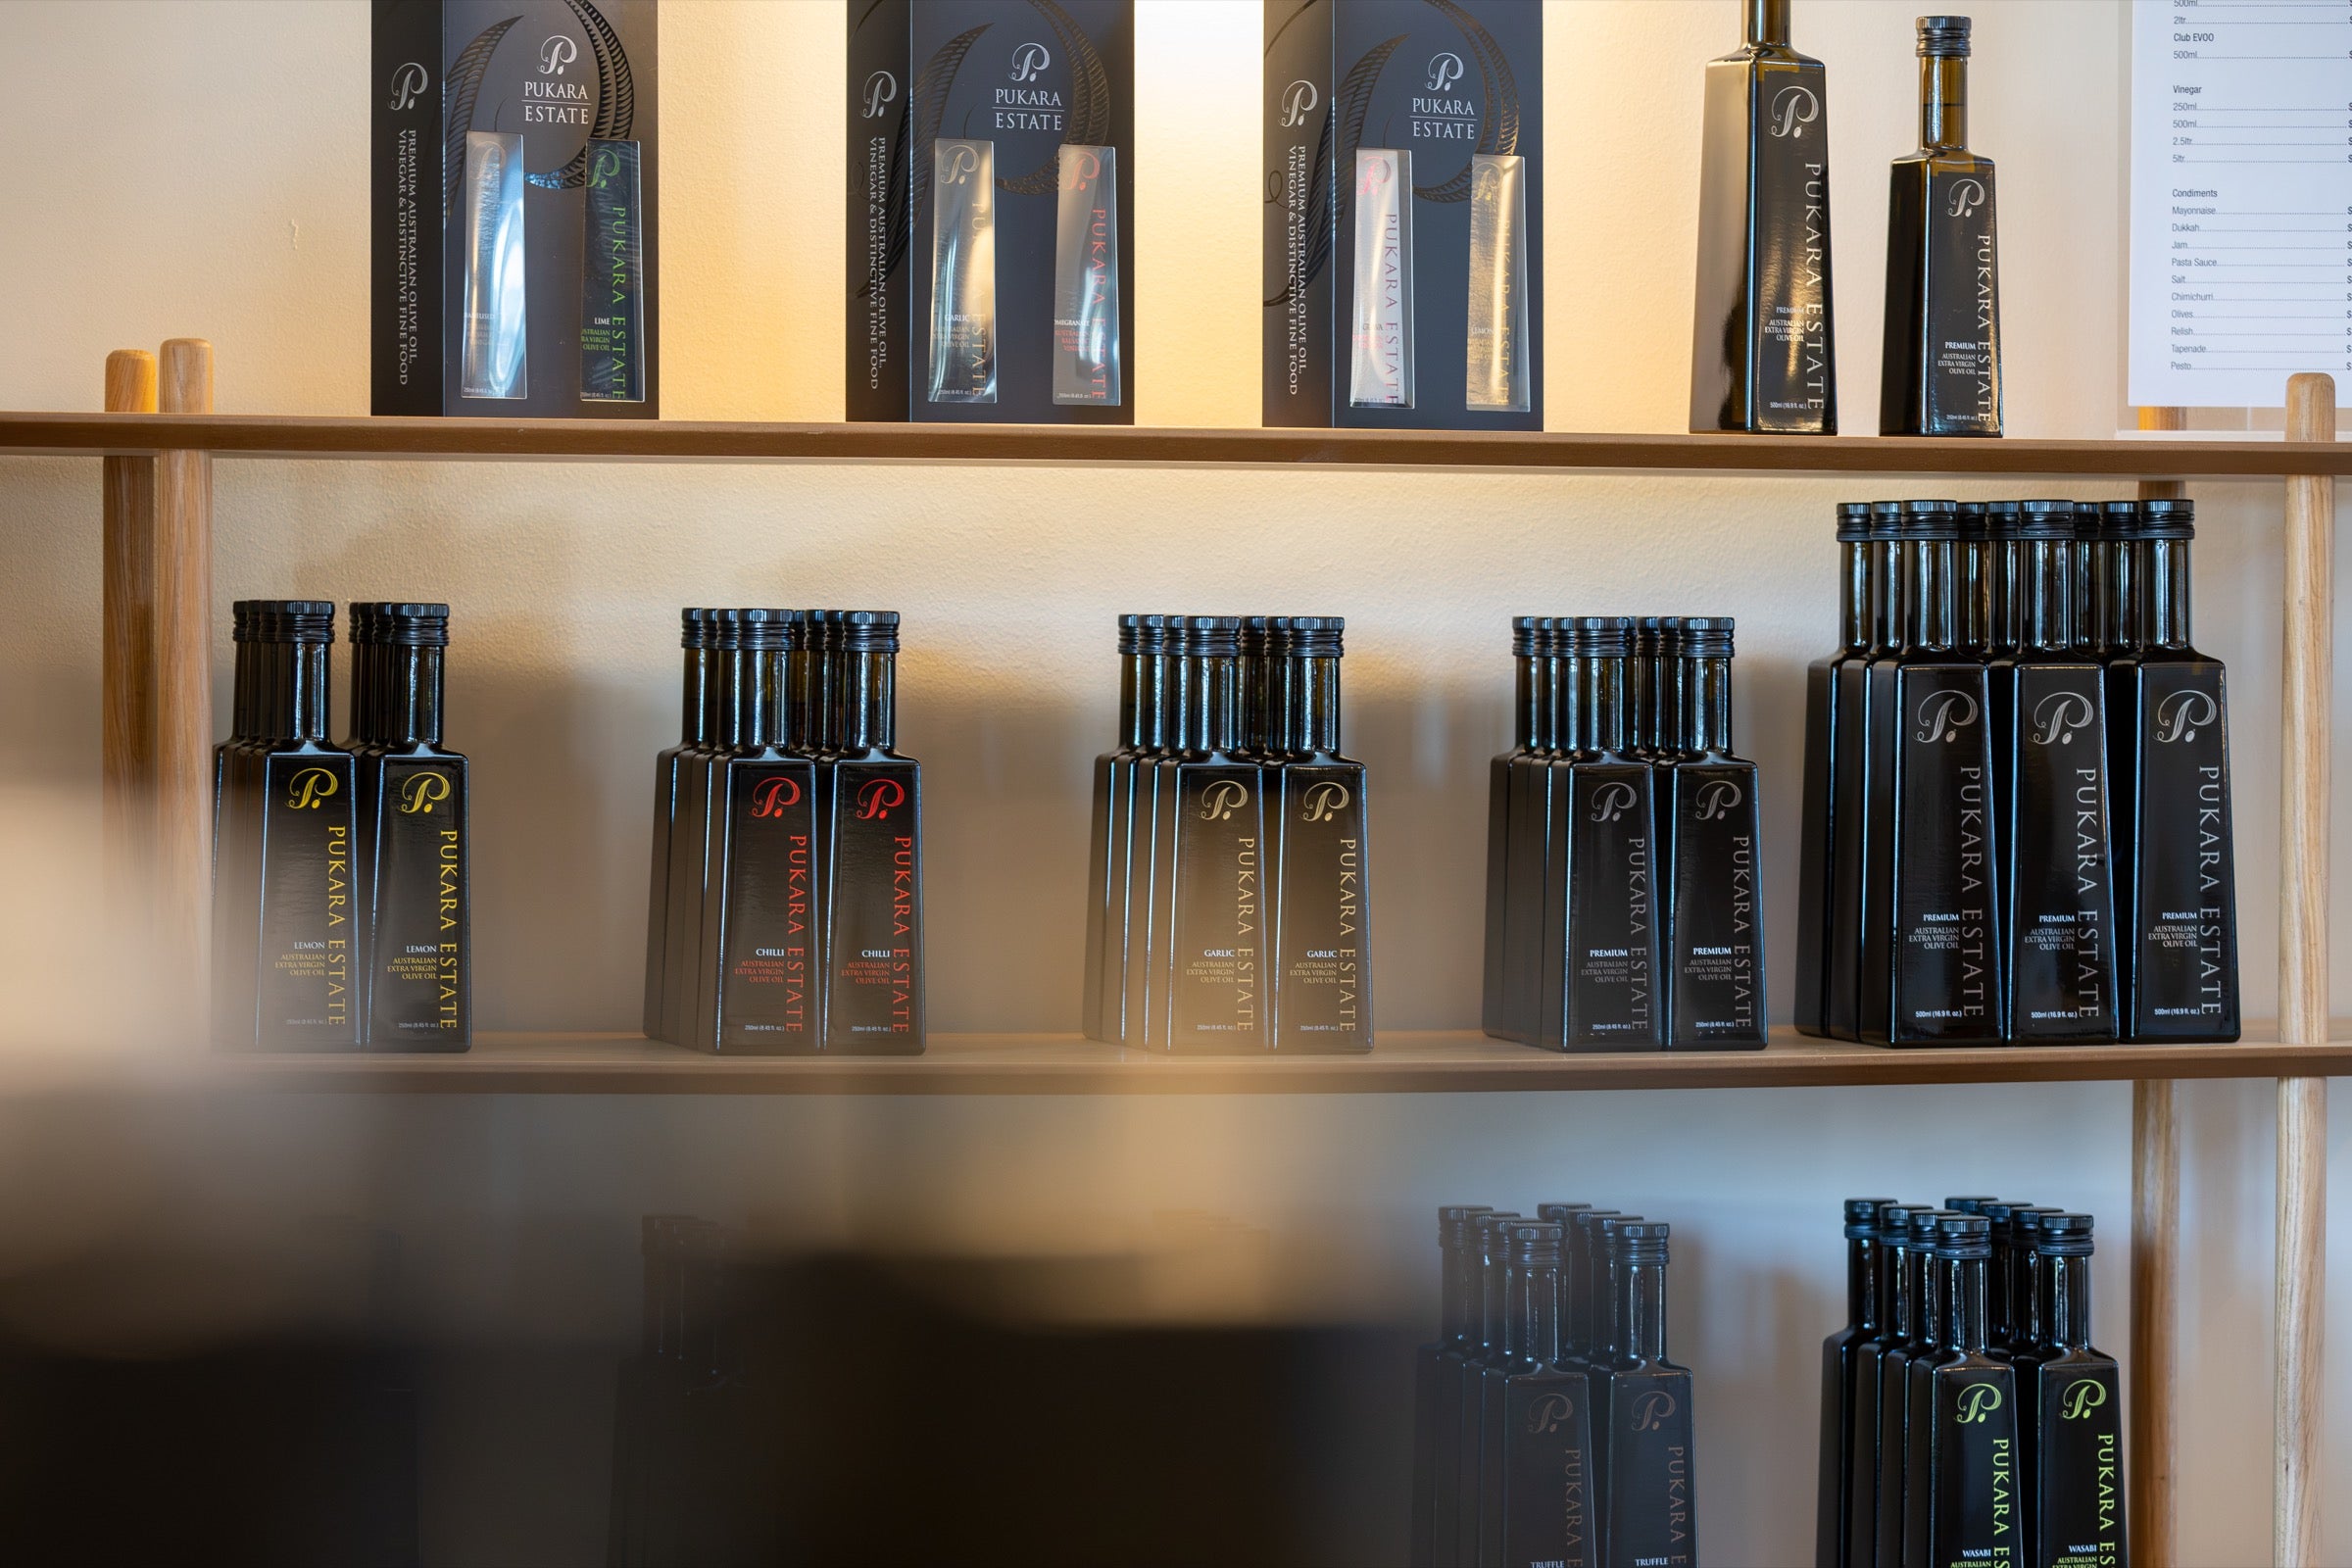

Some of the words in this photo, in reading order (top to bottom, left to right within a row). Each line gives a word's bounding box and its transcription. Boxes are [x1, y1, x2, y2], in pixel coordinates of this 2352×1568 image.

[2174, 33, 2190, 42] Club
[524, 81, 588, 99] PUKARA
[525, 106, 588, 123] ESTATE
[996, 89, 1061, 106] PUKARA
[996, 113, 1061, 130] ESTATE
[1412, 98, 1474, 115] PUKARA
[1413, 122, 1474, 139] ESTATE
[2173, 85, 2202, 95] Vinegar
[2173, 120, 2197, 128] 500ml
[399, 197, 407, 209] &
[870, 204, 877, 215] &
[1289, 213, 1297, 222] &
[1805, 162, 1823, 286] PUKARA
[2172, 207, 2216, 216] Mayonnaise
[2172, 223, 2199, 232] Dukkah
[612, 206, 626, 304] PUKARA
[1092, 208, 1106, 304] PUKARA
[1384, 214, 1399, 309] PUKARA
[1978, 234, 1991, 329] PUKARA
[2172, 258, 2192, 267] Pasta
[2194, 258, 2217, 267] Sauce
[2172, 275, 2186, 284] Salt
[612, 317, 626, 399] ESTATE
[1092, 318, 1105, 399] ESTATE
[1386, 322, 1398, 404] ESTATE
[1806, 304, 1824, 409] ESTATE
[1945, 341, 1976, 350] PREMIUM
[1978, 341, 1991, 421] ESTATE
[2171, 362, 2191, 370] Pesto
[2172, 345, 2207, 355] Tapenade
[1960, 766, 1982, 893] PUKARA
[2077, 768, 2098, 895] PUKARA
[2199, 765, 2221, 892] PUKARA
[328, 826, 345, 927] PUKARA
[440, 830, 457, 931] PUKARA
[789, 836, 807, 935] PUKARA
[894, 837, 911, 937] PUKARA
[1238, 838, 1254, 935] PUKARA
[1340, 839, 1356, 936] PUKARA
[1629, 838, 1646, 935] PUKARA
[1733, 836, 1750, 933] PUKARA
[328, 940, 345, 1025] ESTATE
[440, 943, 457, 1029] ESTATE
[786, 948, 805, 1032] ESTATE
[893, 949, 910, 1033] ESTATE
[1237, 948, 1253, 1031] ESTATE
[1340, 949, 1356, 1031] ESTATE
[1631, 947, 1648, 1030] ESTATE
[1734, 945, 1751, 1027] ESTATE
[1962, 908, 1984, 1017] ESTATE
[2078, 909, 2099, 1017] ESTATE
[2200, 907, 2222, 1014] ESTATE
[1565, 1449, 1583, 1545] PUKARA
[1669, 1446, 1687, 1544] PUKARA
[1992, 1438, 2010, 1536] PUKARA
[2097, 1434, 2115, 1531] PUKARA
[1635, 1557, 1669, 1567] TRUFFLE
[2058, 1555, 2097, 1564] AUSTRALIAN
